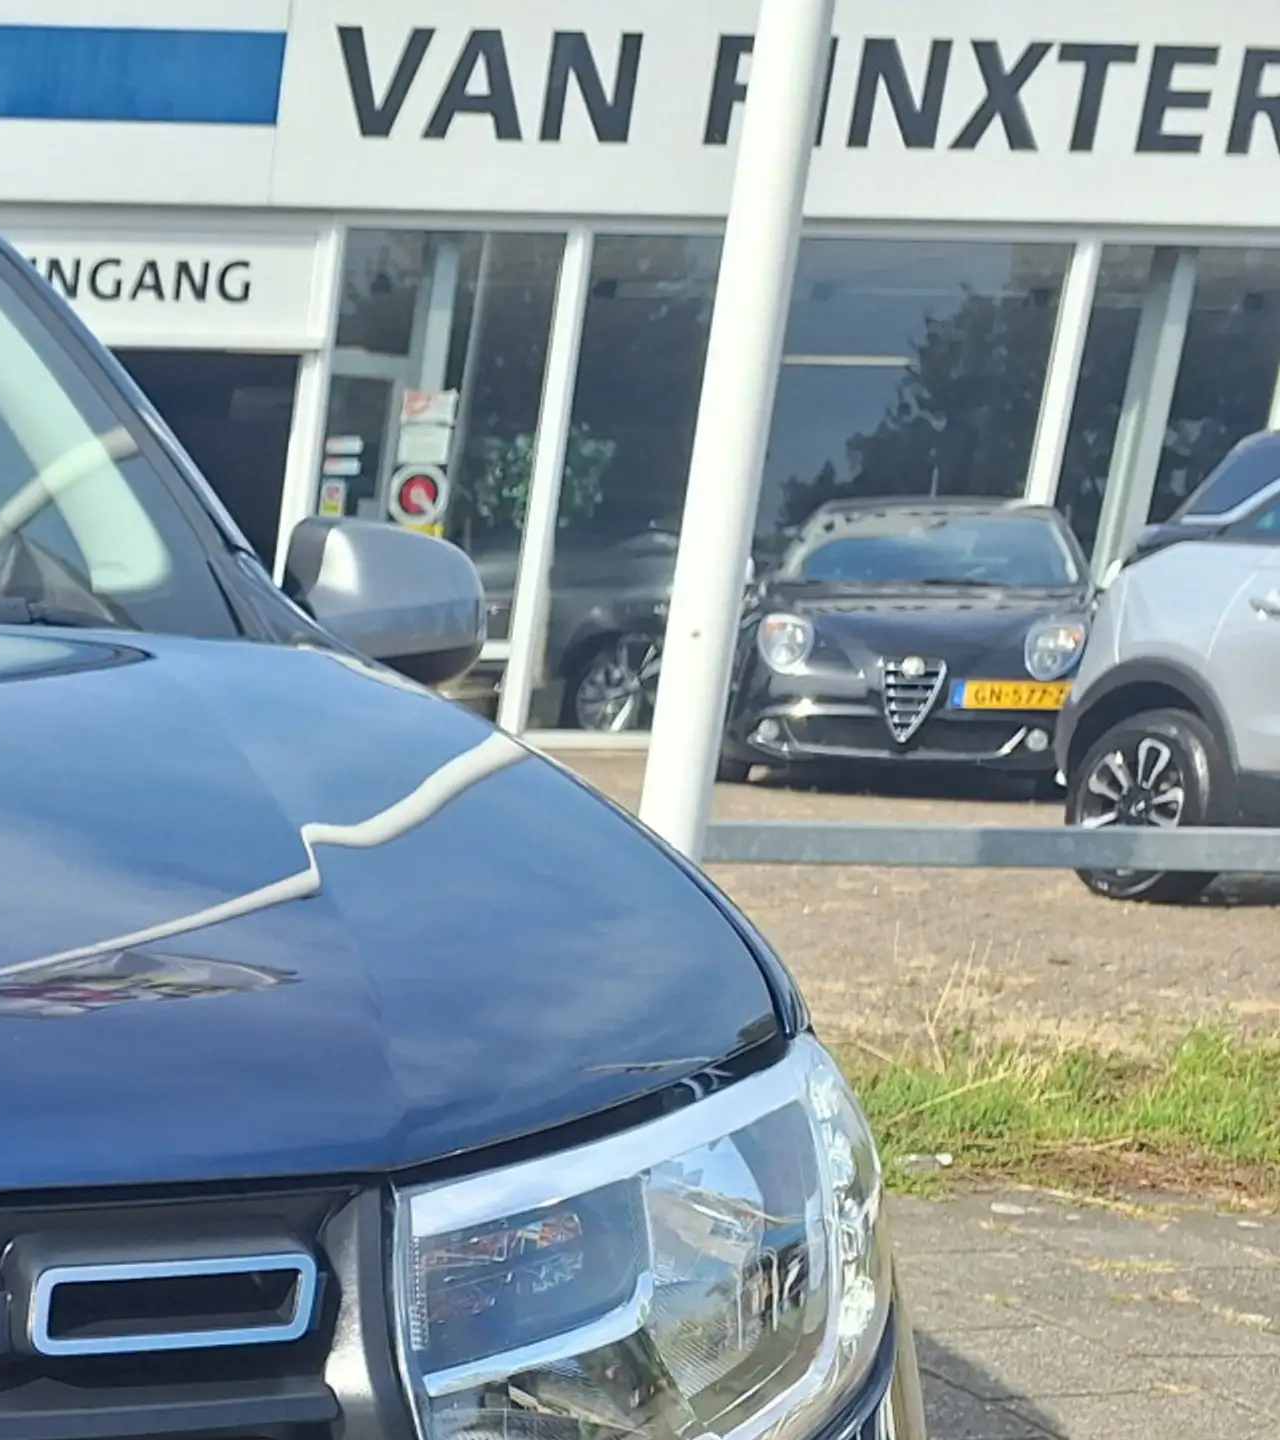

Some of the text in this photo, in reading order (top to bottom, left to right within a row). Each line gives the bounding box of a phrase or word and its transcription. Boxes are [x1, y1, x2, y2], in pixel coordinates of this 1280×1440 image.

[336, 25, 1280, 156] VAN PNXTER
[28, 256, 252, 304] NGANG
